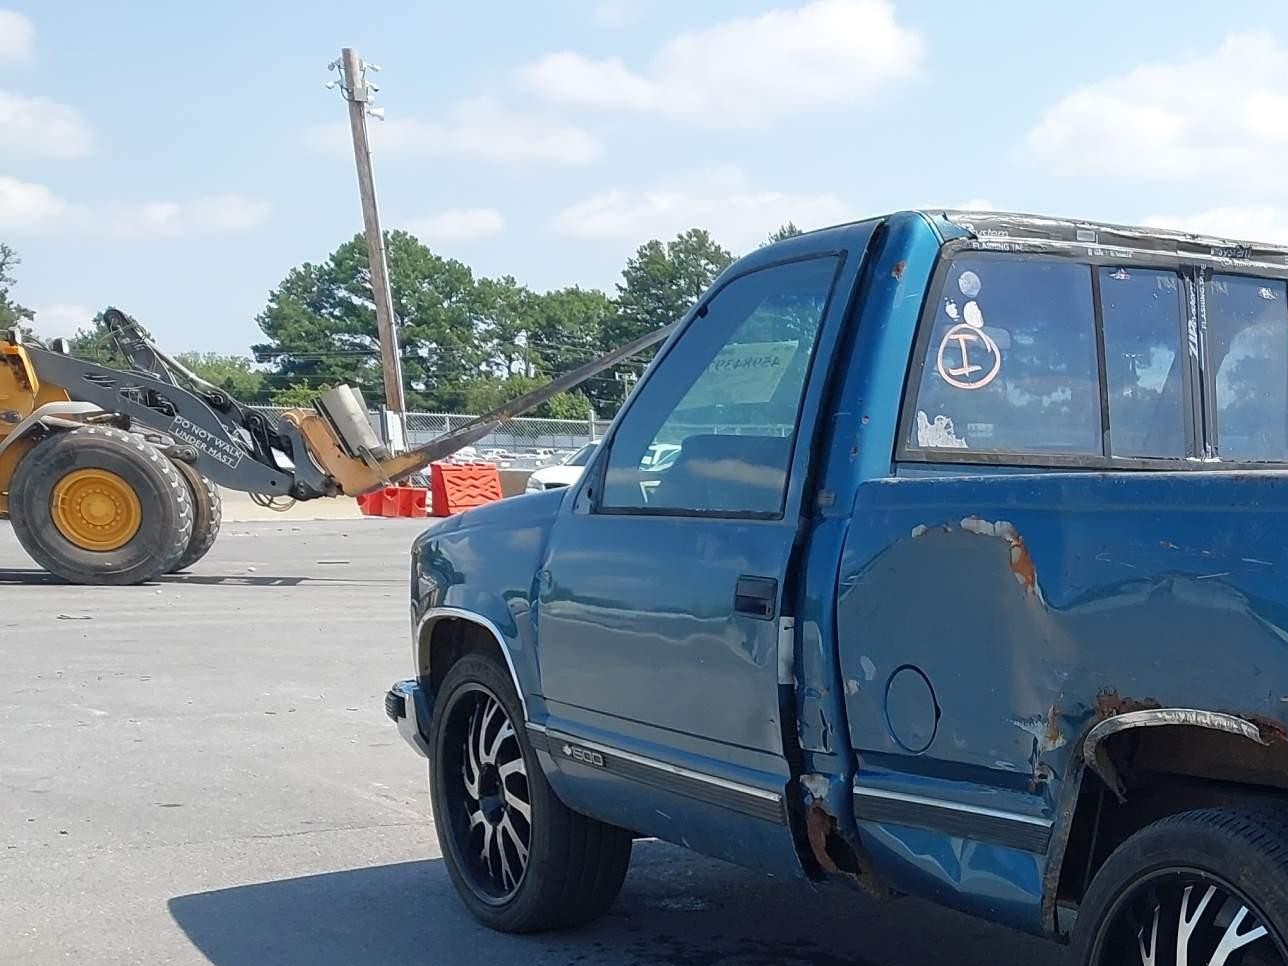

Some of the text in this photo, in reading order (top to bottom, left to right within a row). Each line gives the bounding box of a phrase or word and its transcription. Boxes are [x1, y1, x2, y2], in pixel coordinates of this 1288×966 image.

[174, 415, 190, 428] DO
[191, 423, 214, 441] NOT
[214, 438, 241, 459] WALK
[175, 428, 207, 452] UNDER
[208, 448, 235, 466] MAST
